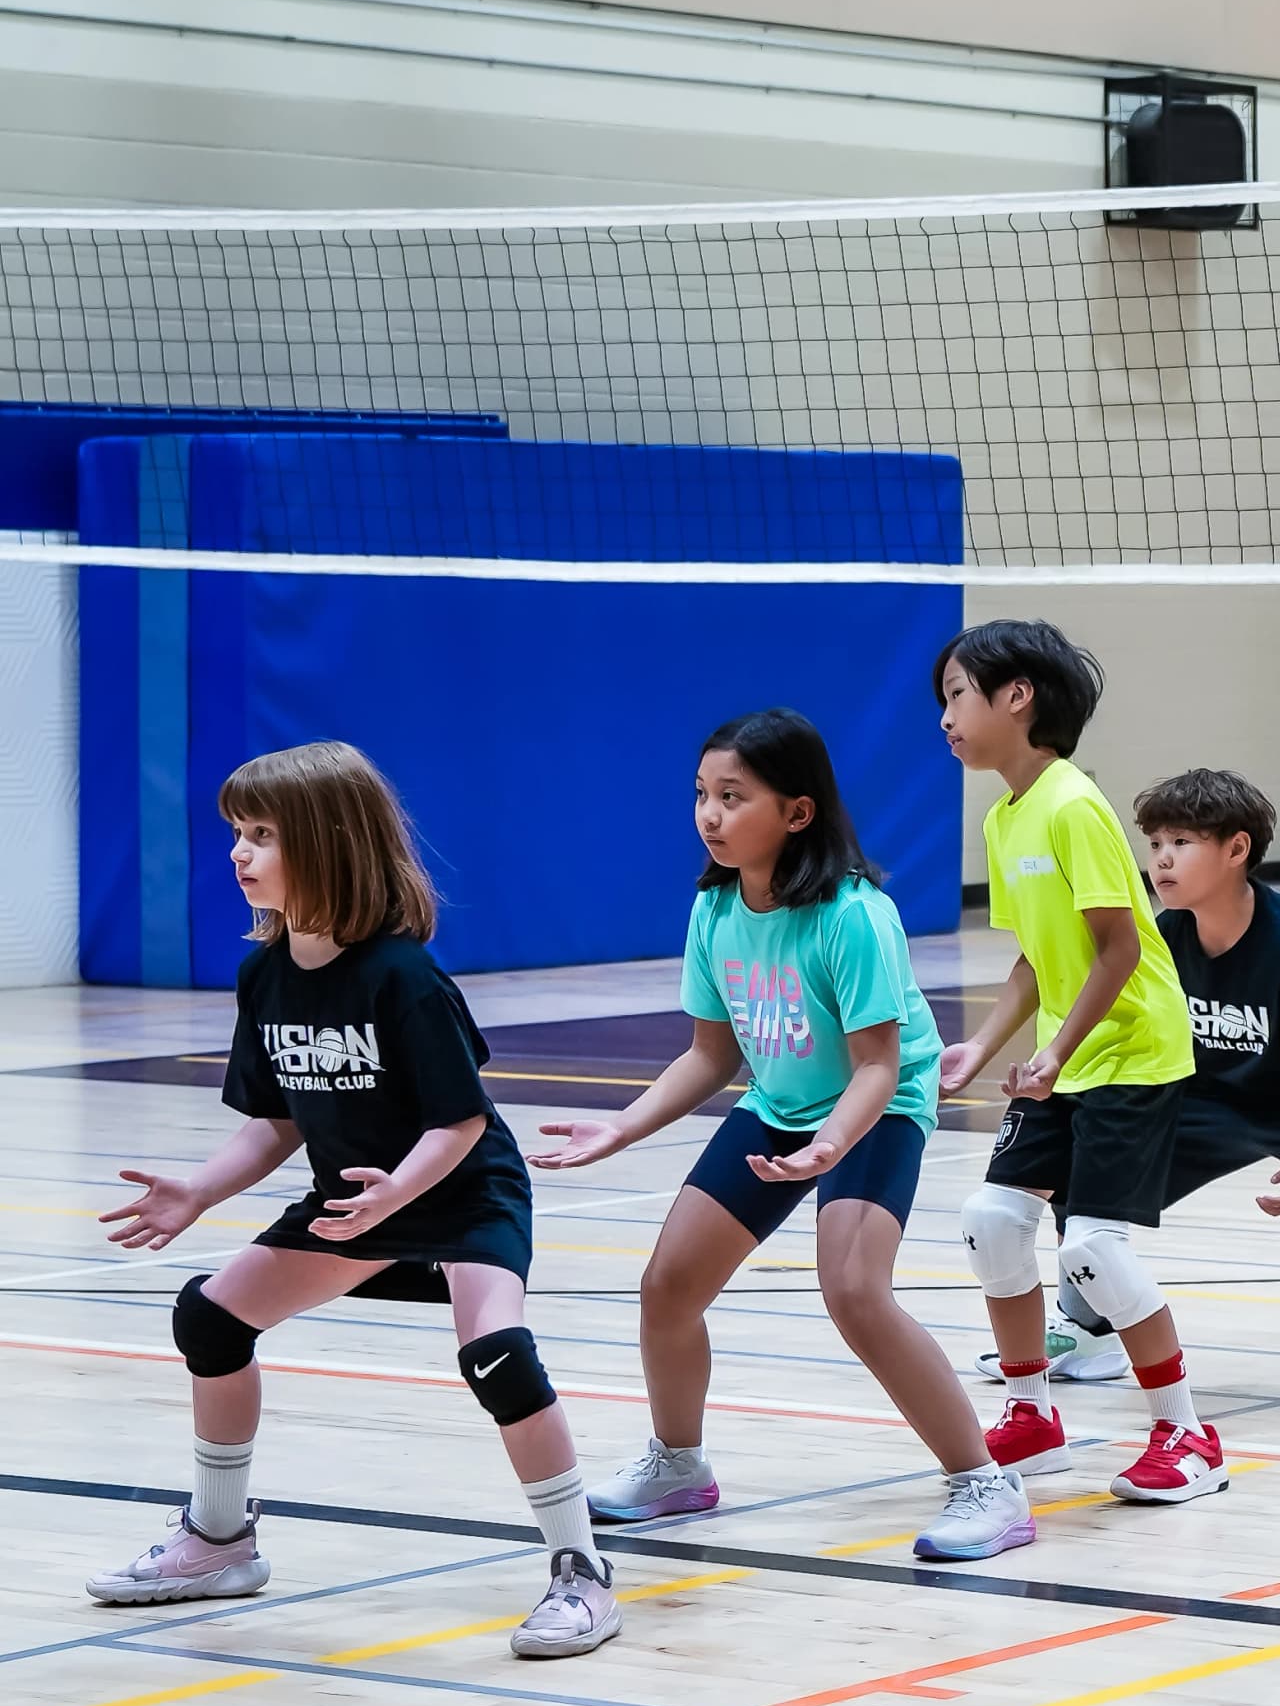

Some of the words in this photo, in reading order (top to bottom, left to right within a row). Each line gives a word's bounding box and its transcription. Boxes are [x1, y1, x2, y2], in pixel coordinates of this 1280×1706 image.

[1188, 996, 1269, 1044] SION
[1236, 1042, 1263, 1055] CLUB
[335, 1074, 376, 1090] CLUB
